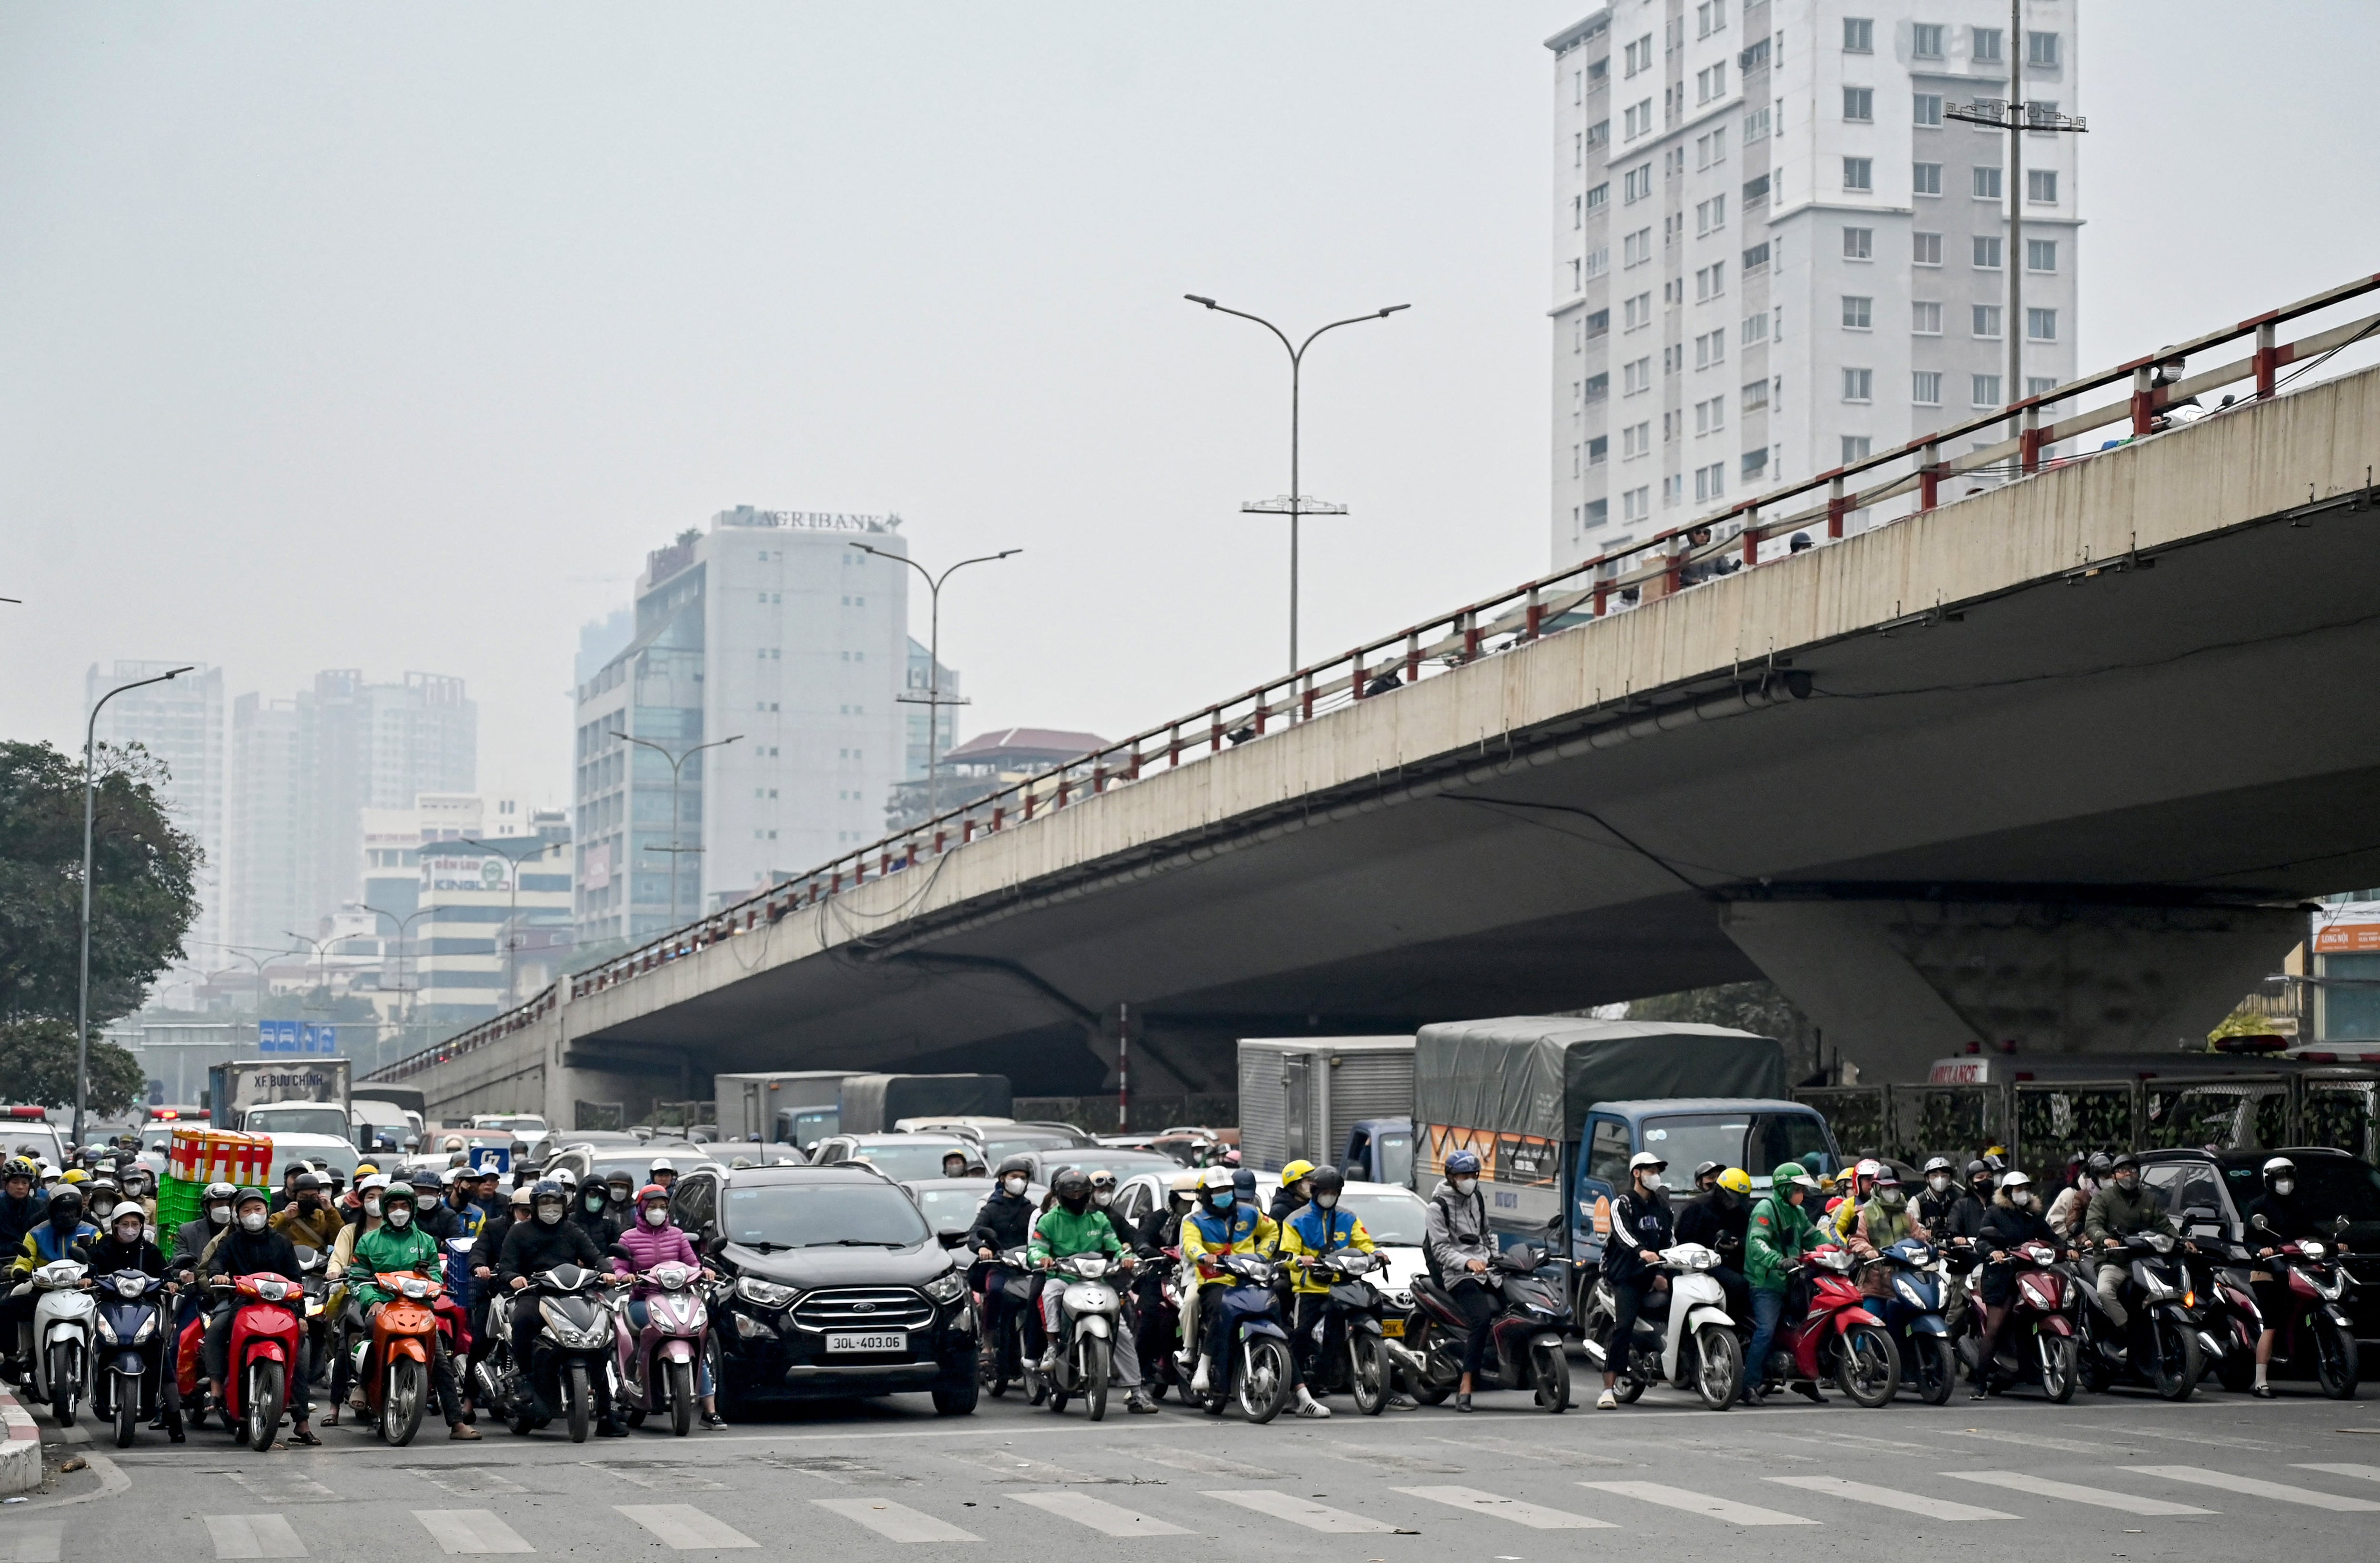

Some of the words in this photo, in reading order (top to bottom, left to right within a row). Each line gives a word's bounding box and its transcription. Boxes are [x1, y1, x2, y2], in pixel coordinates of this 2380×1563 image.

[763, 510, 881, 531] AGRIBANK
[2322, 933, 2337, 944] LONG
[481, 1150, 500, 1167] G7
[833, 1337, 900, 1348] 30L-403.06
